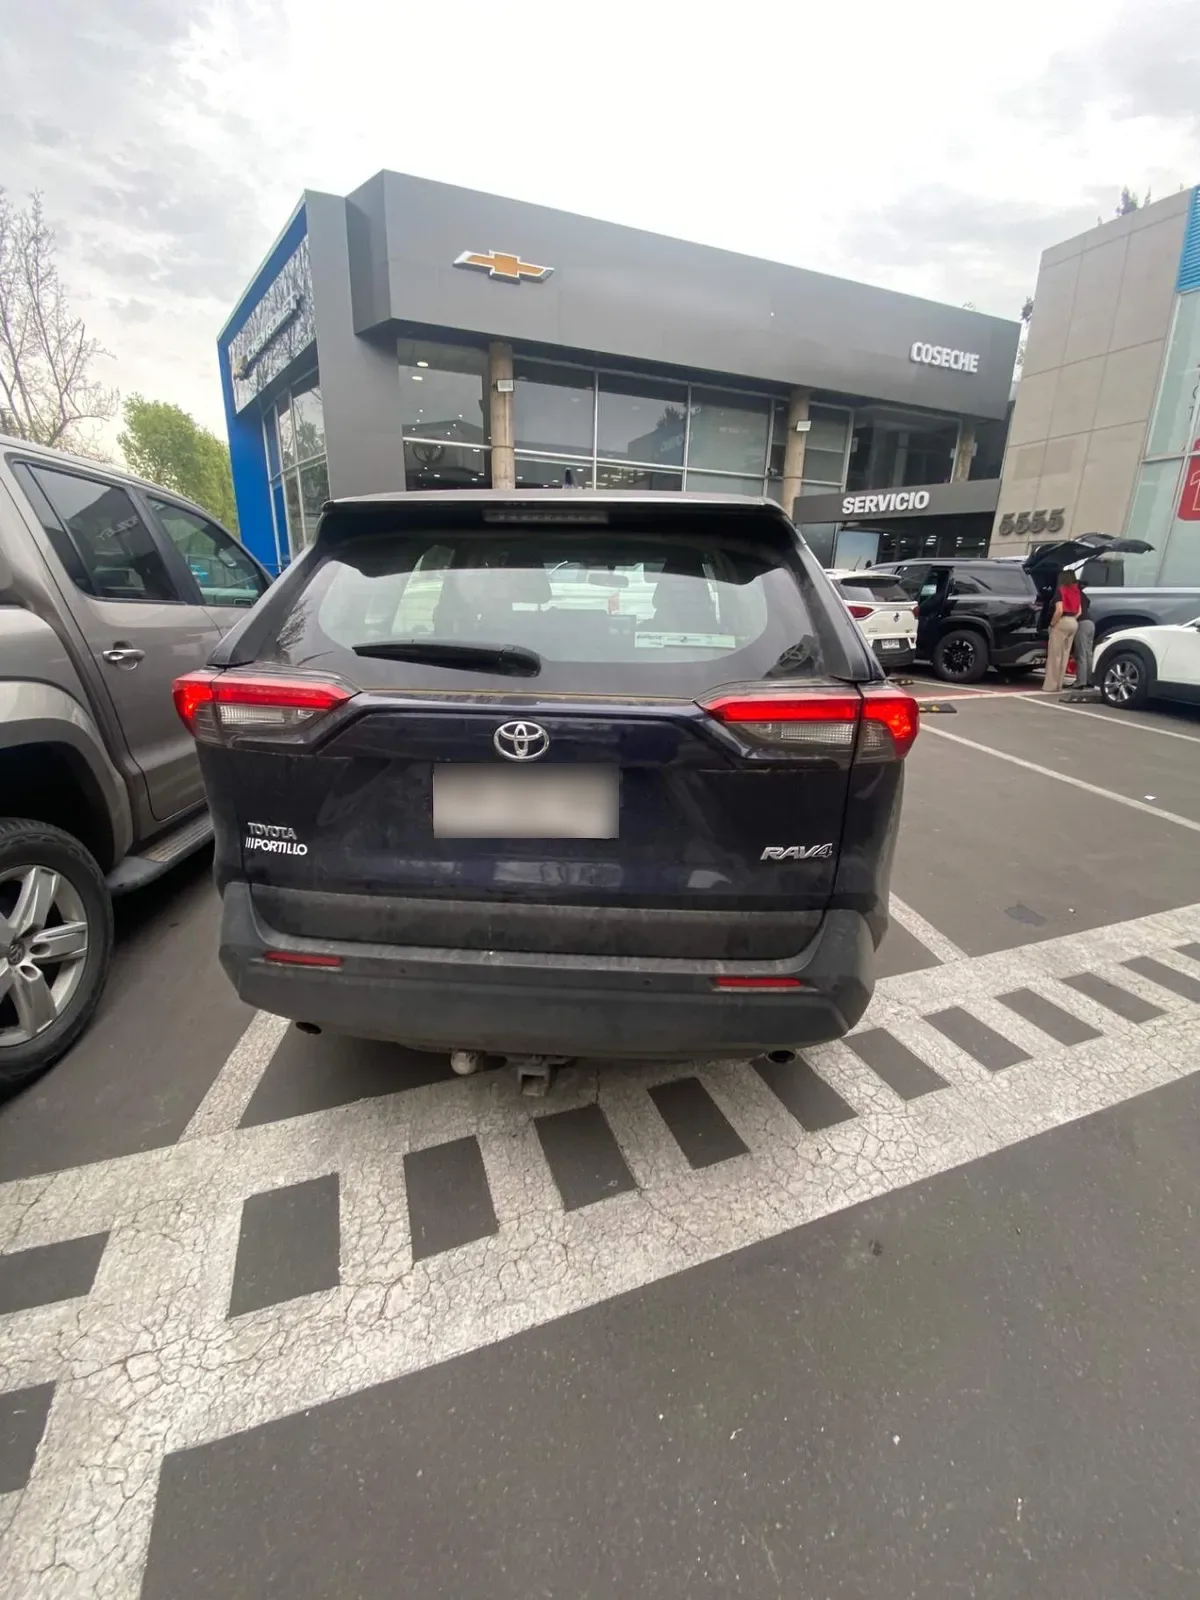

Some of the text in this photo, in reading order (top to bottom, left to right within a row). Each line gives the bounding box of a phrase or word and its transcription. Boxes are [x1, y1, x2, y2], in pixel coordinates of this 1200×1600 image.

[910, 341, 979, 373] COSECHE
[841, 490, 930, 514] SERVICIO
[999, 508, 1065, 535] 5555
[247, 821, 297, 840] TOYOTA
[253, 838, 308, 856] PORTILLO
[760, 843, 833, 860] RAV4
